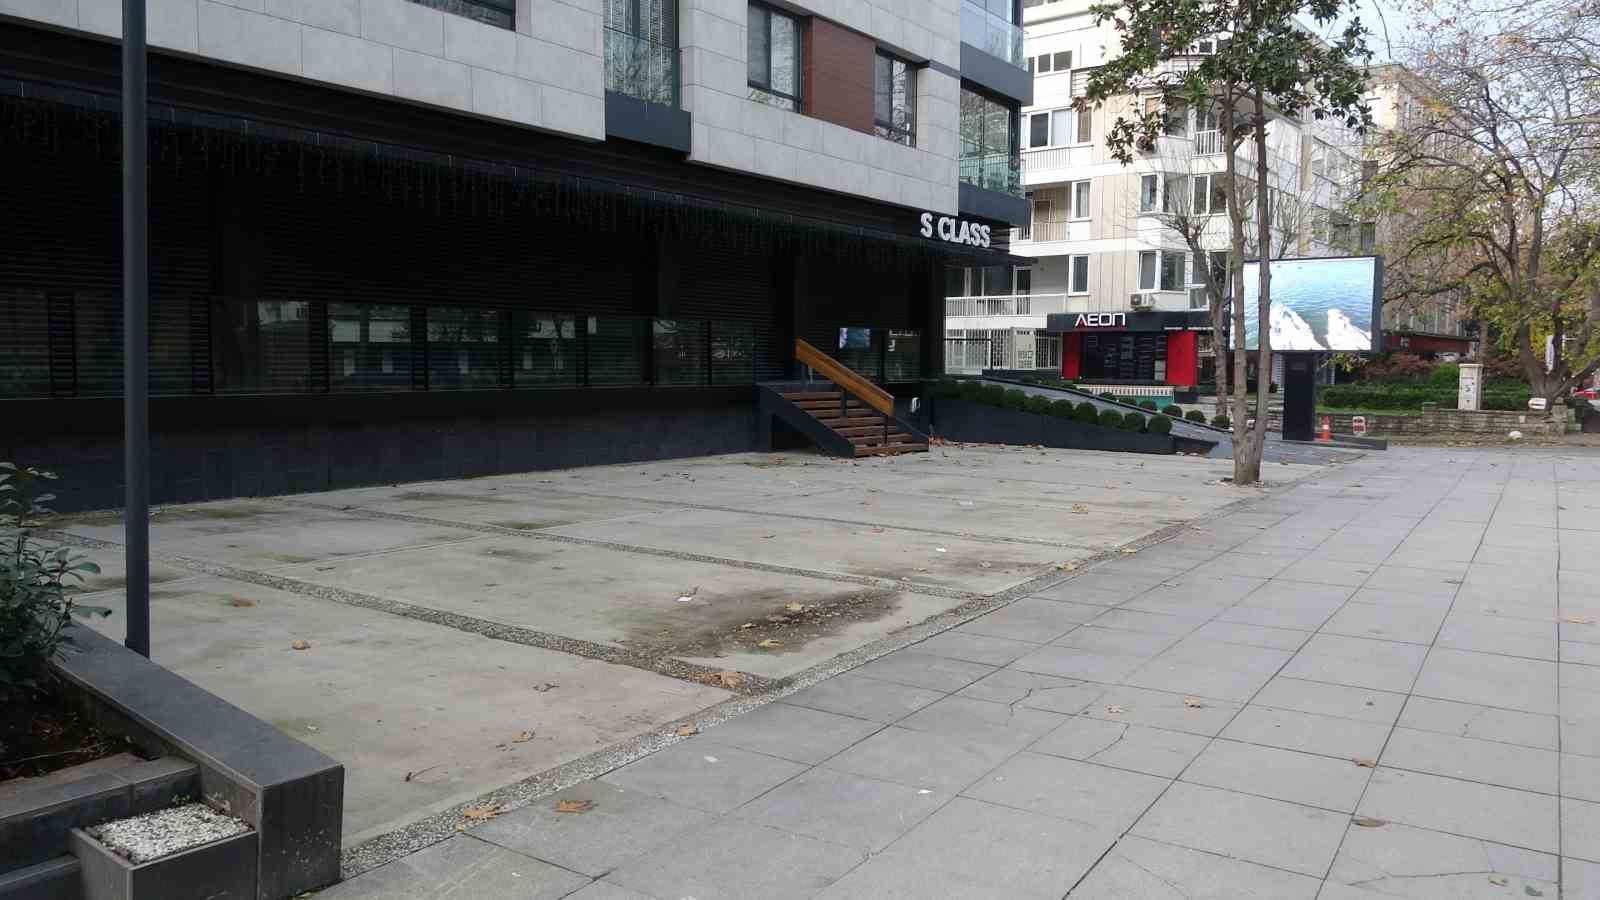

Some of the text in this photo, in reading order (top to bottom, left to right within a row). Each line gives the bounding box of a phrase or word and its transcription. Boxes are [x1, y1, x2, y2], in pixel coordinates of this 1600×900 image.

[920, 212, 991, 248] S CLASS
[1074, 312, 1126, 327] AEON
